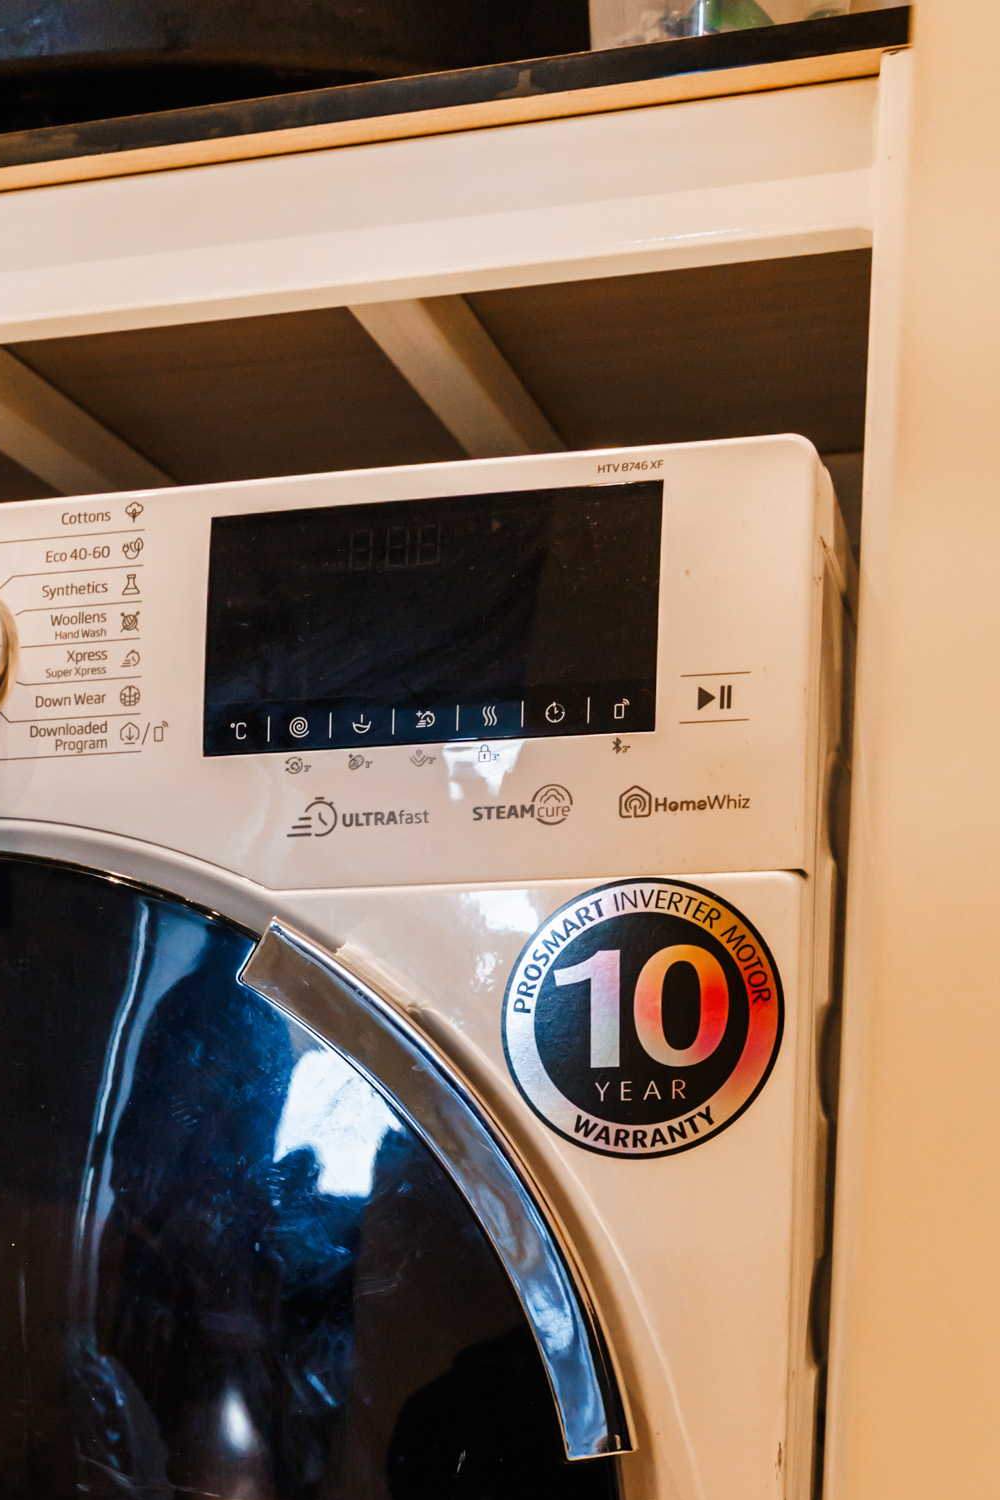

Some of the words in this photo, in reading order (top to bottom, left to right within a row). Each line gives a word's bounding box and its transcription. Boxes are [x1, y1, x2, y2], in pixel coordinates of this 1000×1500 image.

[597, 463, 620, 474] HTV
[621, 460, 648, 472] 8746
[650, 459, 665, 470] XF
[61, 511, 111, 525] Cottons
[45, 550, 67, 563] Eco
[70, 546, 111, 561] 40-60
[42, 581, 108, 600] Synthetics
[50, 611, 107, 627] Woollens
[54, 629, 80, 641] Hand
[81, 627, 107, 638] Wash
[66, 650, 108, 665] Xpress
[45, 668, 72, 679] Super
[74, 666, 107, 677] Xpress
[35, 695, 71, 708] Down
[73, 693, 107, 706] Wear
[29, 720, 108, 738] Downloaded
[55, 738, 108, 753] Program
[655, 794, 751, 812] HomeWhiz
[342, 809, 429, 828] ULTRAfast
[472, 804, 571, 821] STEAMcure
[513, 898, 605, 1014] PROSMART
[613, 889, 722, 929] INVERTER
[720, 925, 772, 1004] MOTOR
[554, 944, 730, 1069] 10
[594, 1079, 687, 1102] YEAR
[573, 1105, 715, 1148] WARRANTY
